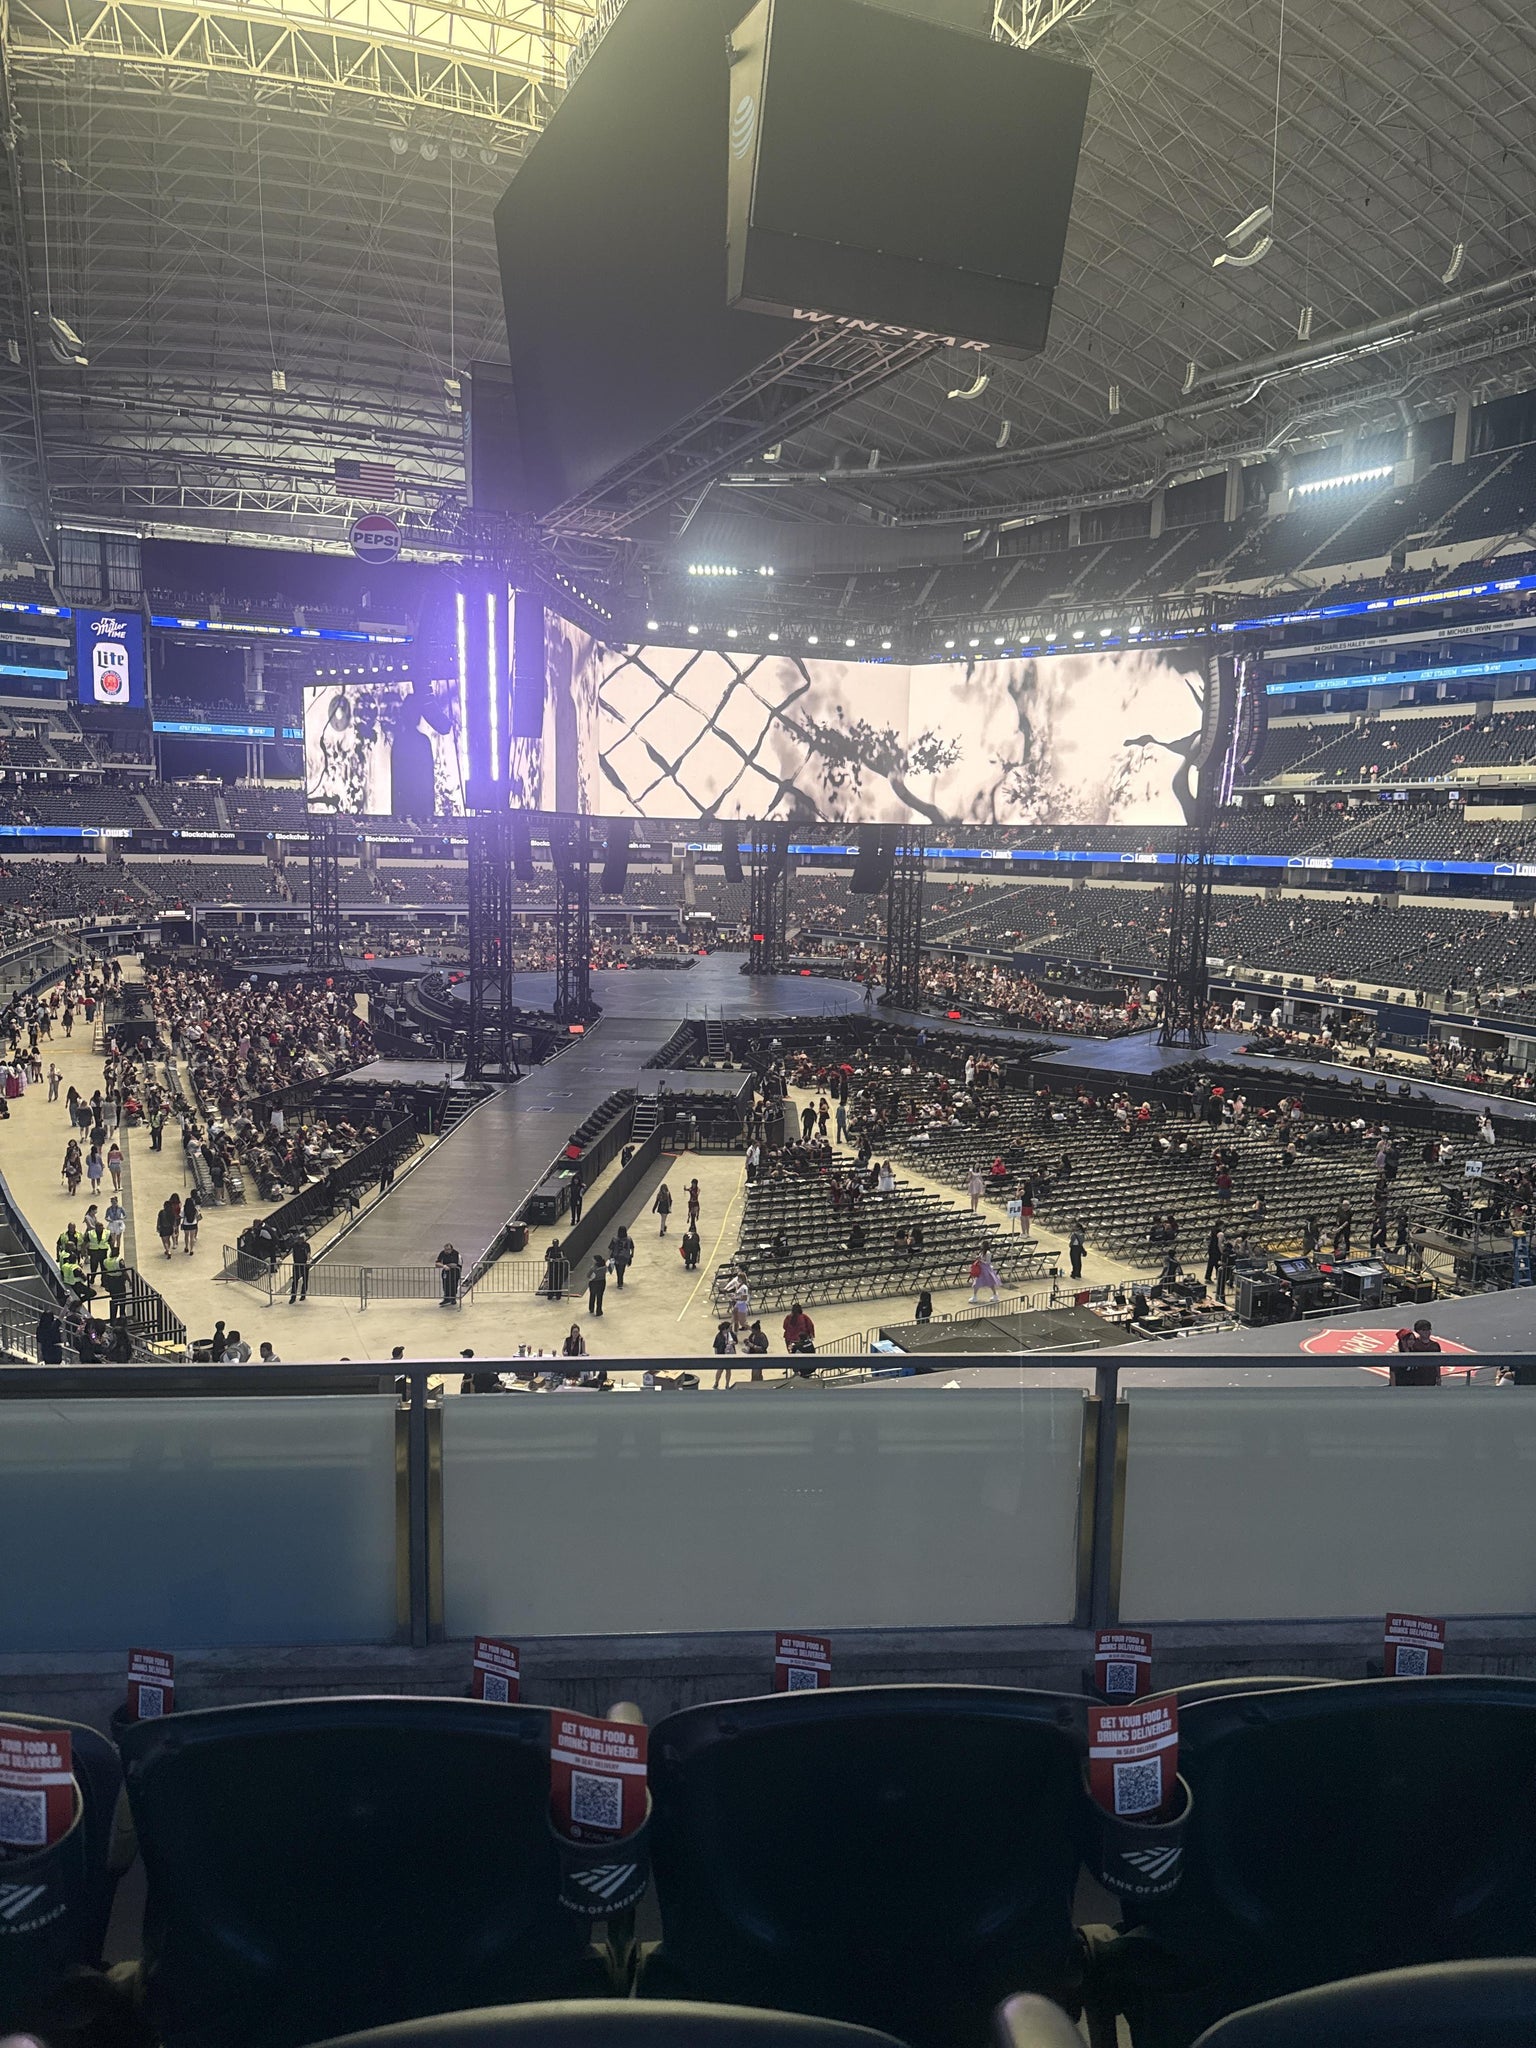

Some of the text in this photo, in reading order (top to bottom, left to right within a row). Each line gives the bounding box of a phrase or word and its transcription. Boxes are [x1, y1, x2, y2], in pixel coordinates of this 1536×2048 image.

[793, 308, 991, 351] WINSTAR
[354, 532, 398, 547] PEPSI
[91, 621, 127, 635] Miller
[1447, 627, 1473, 636] MICHAEL
[1475, 624, 1491, 633] IRVIN
[1321, 643, 1346, 651] CHARLES
[1347, 640, 1366, 649] HALEY
[97, 650, 124, 668] Lite
[100, 828, 129, 838] LOWE'S
[181, 831, 235, 839] Blockchain.com
[1305, 858, 1333, 868] LOWE'S
[1101, 1717, 1116, 1729] GET
[1118, 1715, 1141, 1728] YOUR
[1142, 1709, 1162, 1723] FOOD
[562, 1721, 576, 1734] GET
[579, 1726, 600, 1740] YOUR
[602, 1730, 626, 1743] FOOD
[1097, 1719, 1172, 1742] DRINKS DELIVERED!
[558, 1734, 638, 1759] DRINKS DELIVERED!
[1103, 1871, 1132, 1892] BANK
[1136, 1885, 1151, 1894] OF
[588, 1905, 603, 1915] OF
